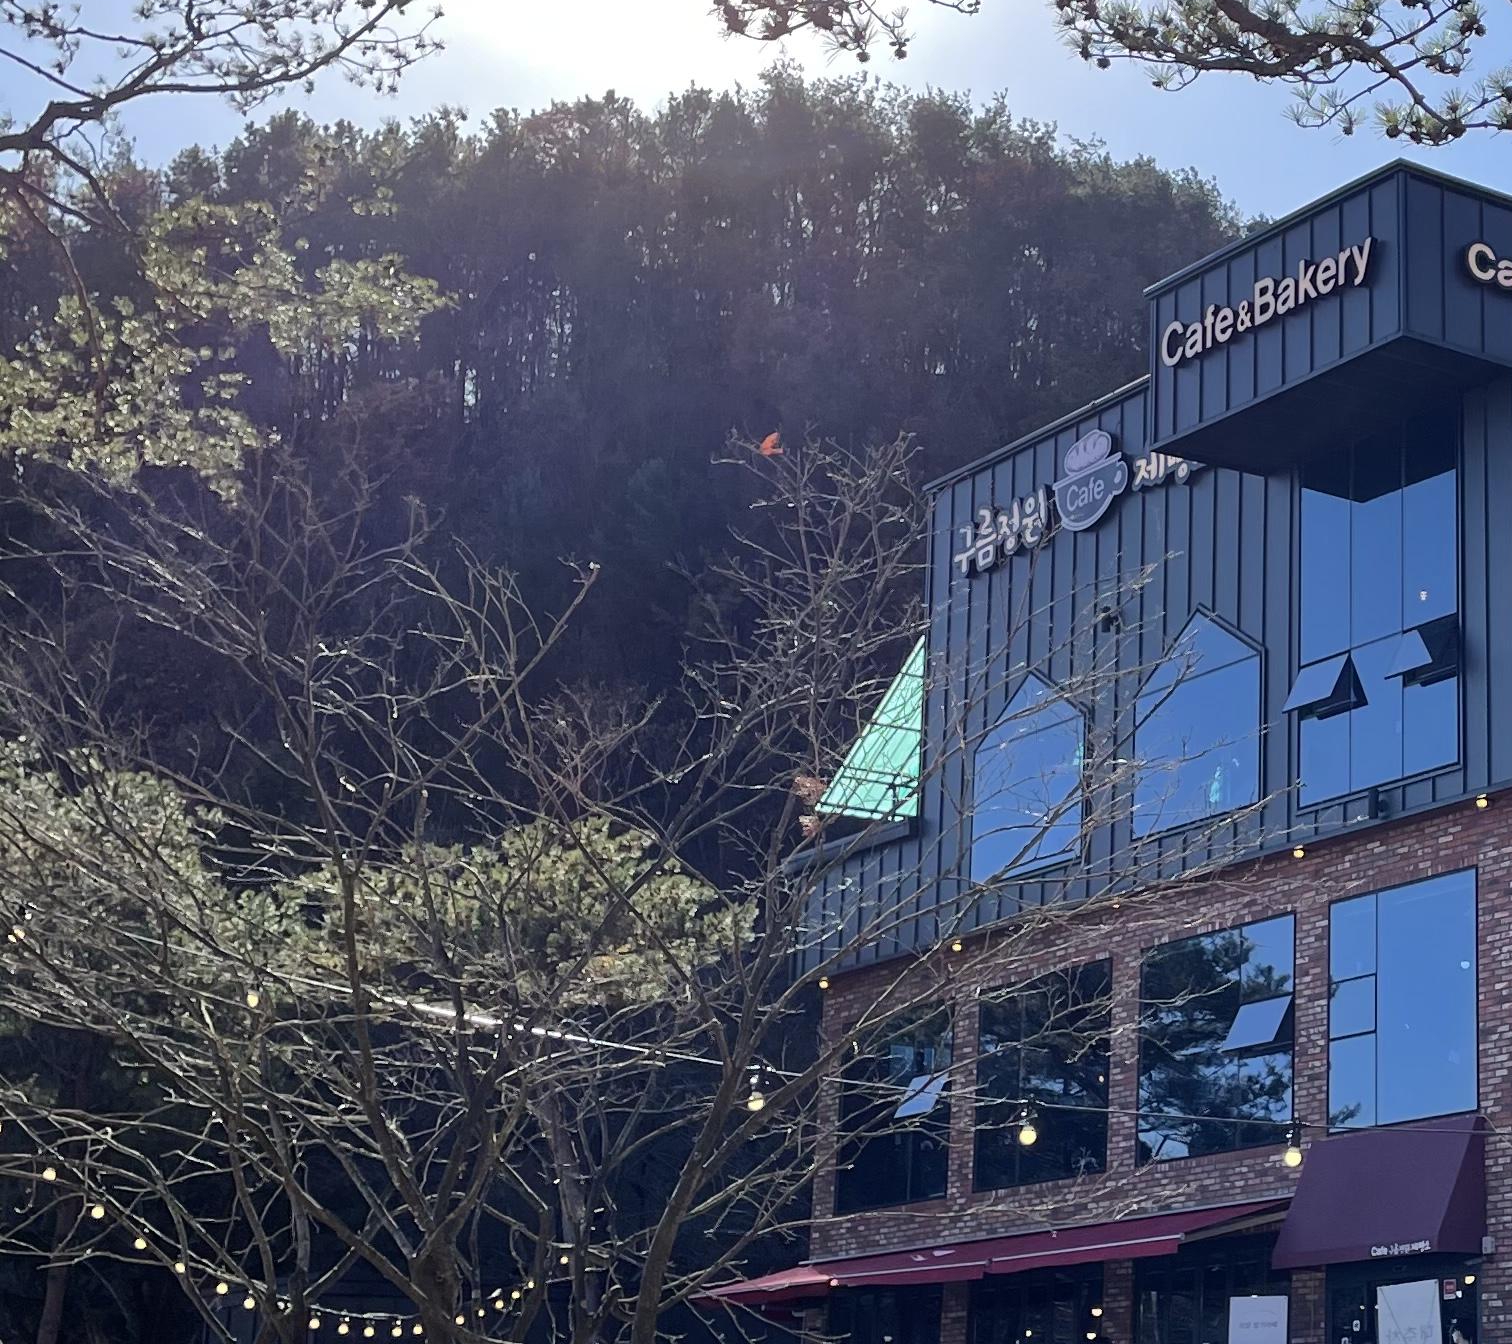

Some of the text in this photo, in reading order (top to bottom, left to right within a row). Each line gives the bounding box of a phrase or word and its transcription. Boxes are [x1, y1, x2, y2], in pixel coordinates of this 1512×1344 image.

[1161, 236, 1374, 367] Cafe&Bakery
[953, 488, 1046, 573] 구름정원
[1066, 476, 1105, 512] Cafe
